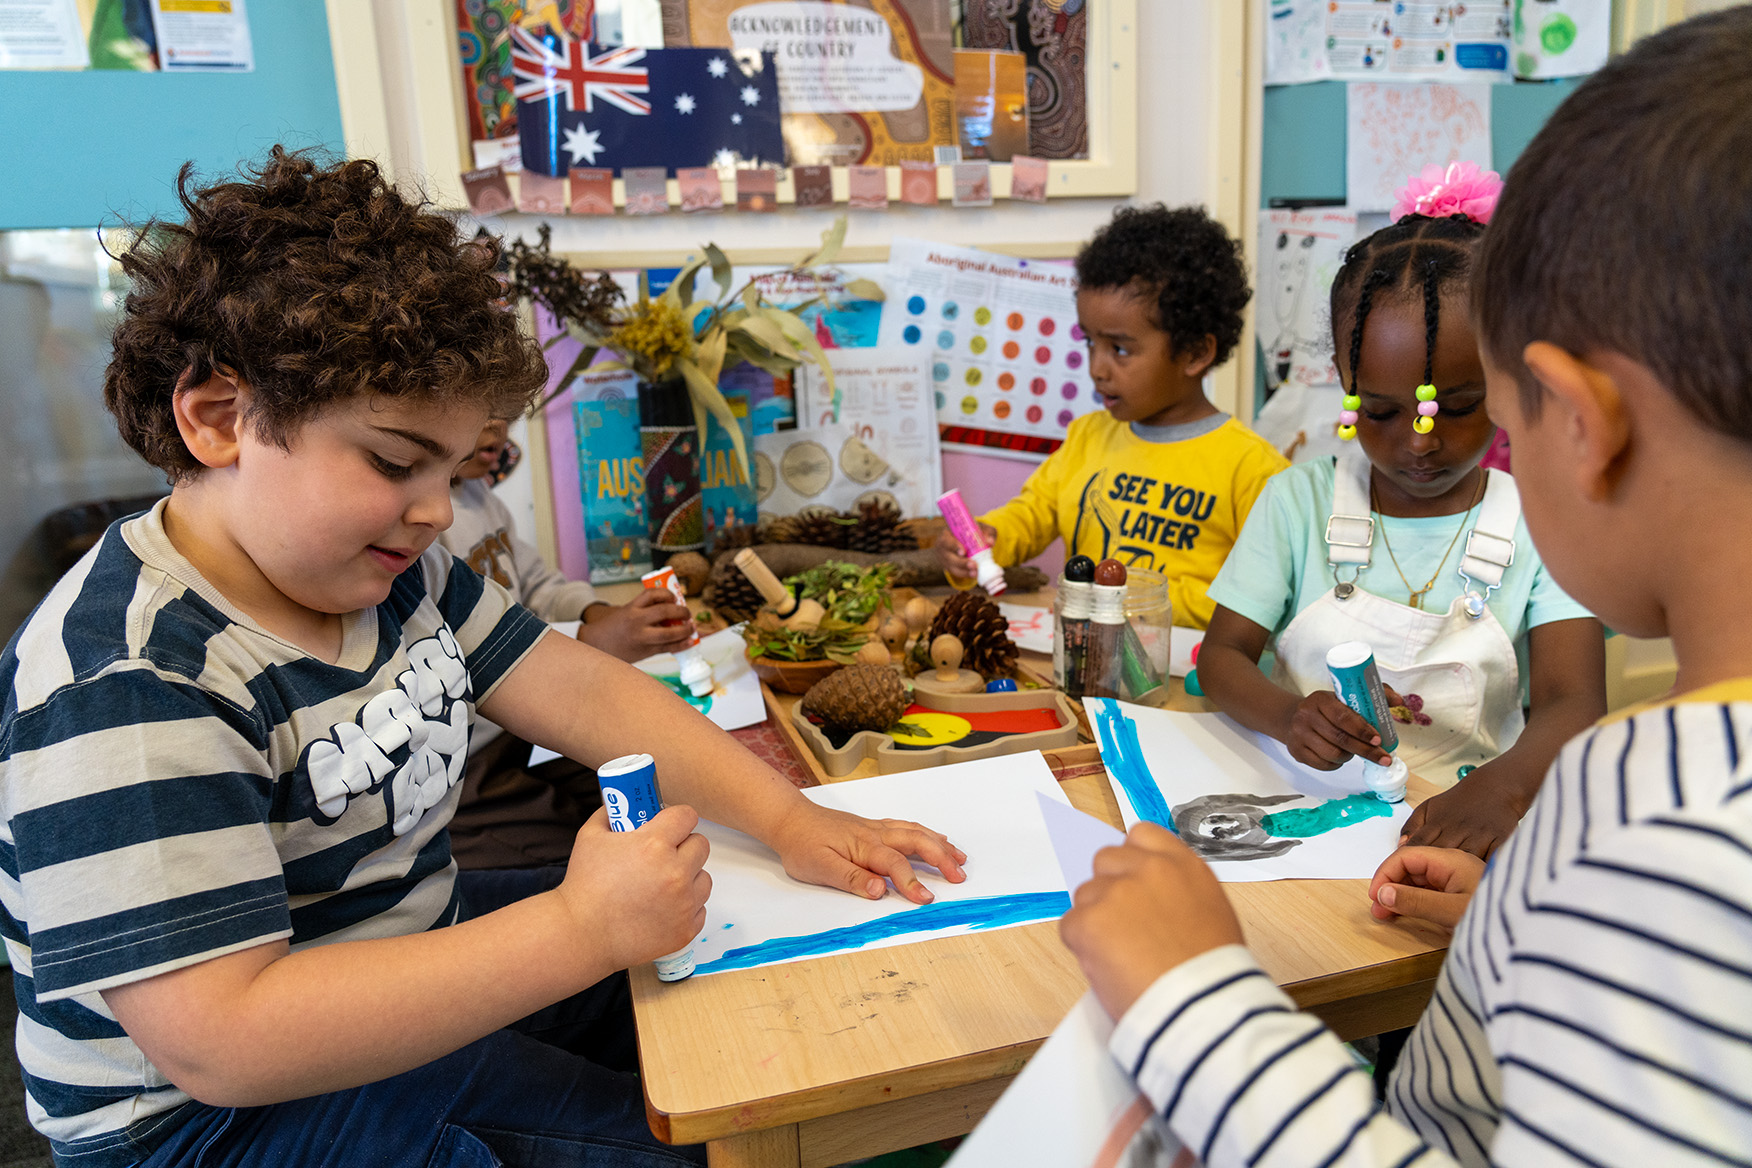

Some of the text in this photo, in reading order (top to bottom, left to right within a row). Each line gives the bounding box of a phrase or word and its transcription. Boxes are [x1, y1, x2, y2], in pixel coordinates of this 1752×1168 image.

[730, 16, 884, 35] ACKNOWLEDGEMENT
[787, 41, 856, 57] COUNTRY
[926, 252, 985, 272] Aboriginal
[988, 264, 1046, 283] Australian
[1049, 274, 1067, 286] Art
[1108, 473, 1217, 521] SEE YOU
[1120, 509, 1200, 550] LATER
[393, 700, 468, 836] BOY
[607, 793, 625, 832] Blue
